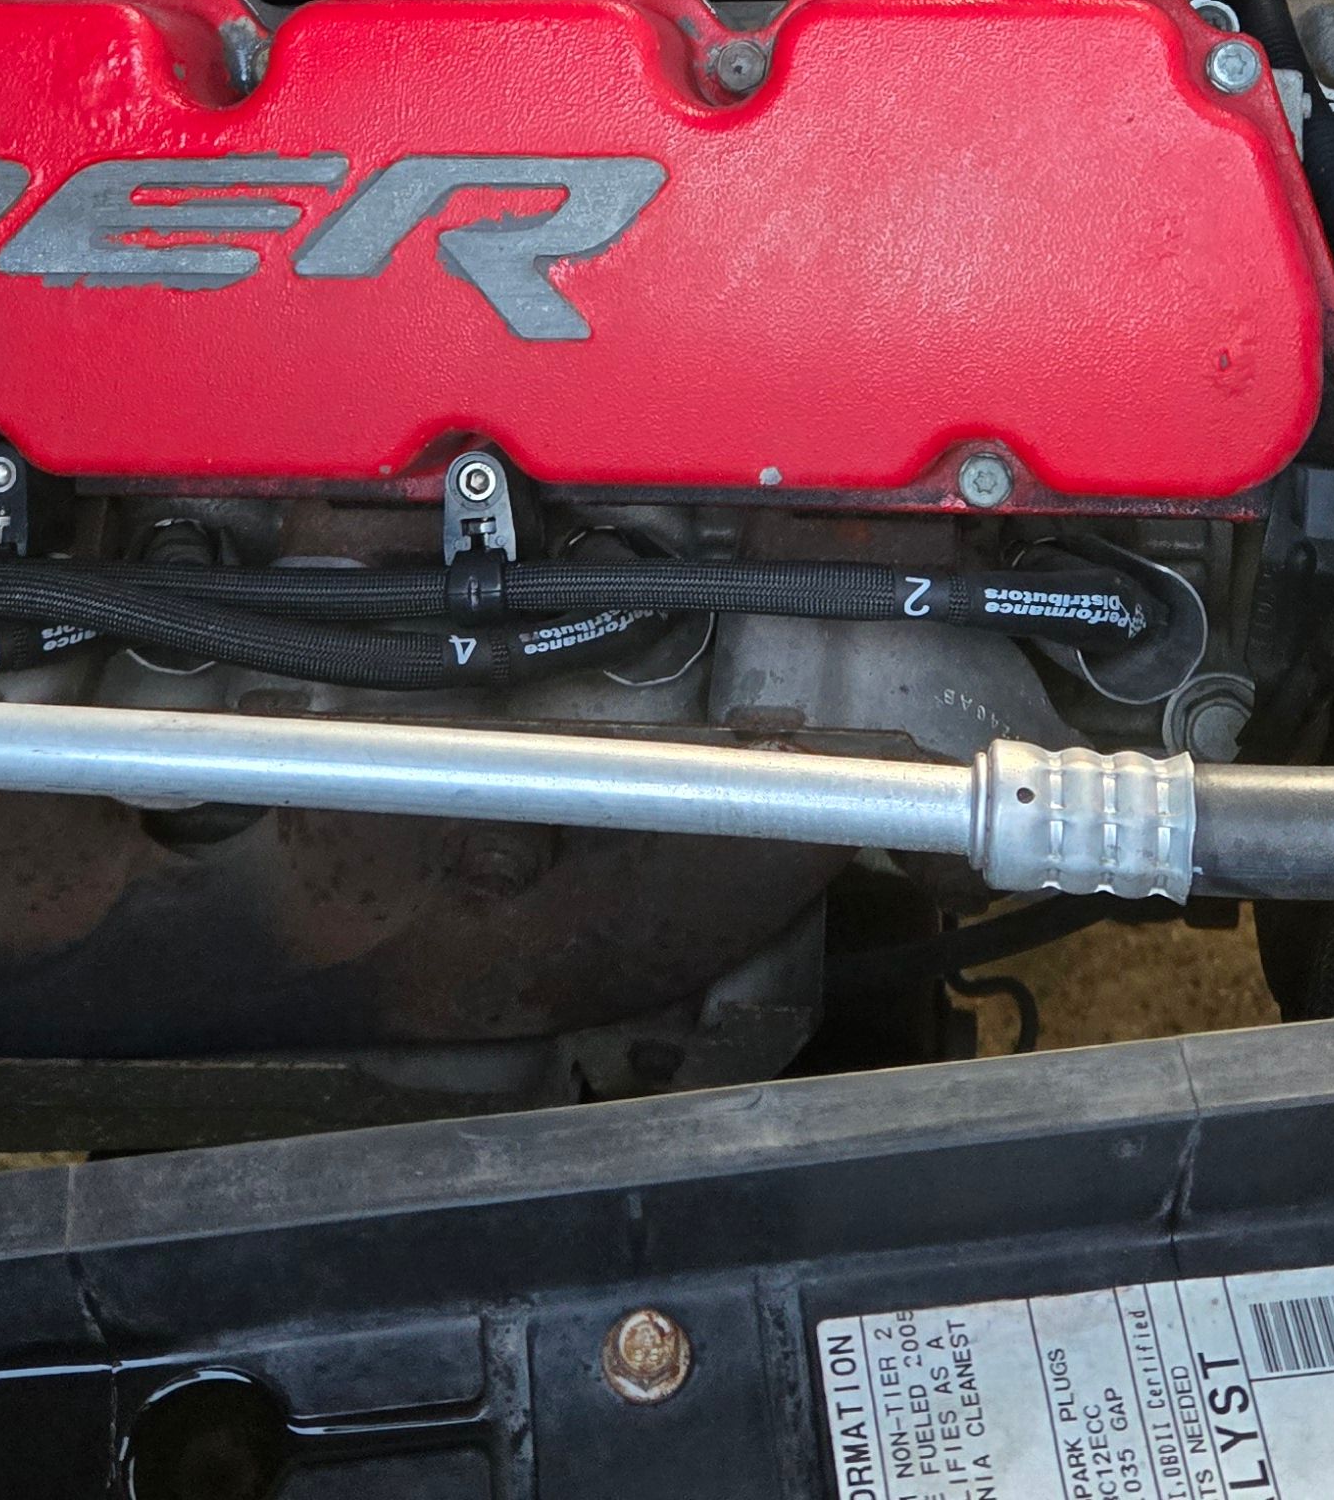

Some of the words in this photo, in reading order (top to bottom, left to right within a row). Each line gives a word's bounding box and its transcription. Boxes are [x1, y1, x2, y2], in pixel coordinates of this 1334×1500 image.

[903, 576, 932, 617] 2
[984, 587, 1120, 610] Distributors
[984, 601, 1130, 628] Performance
[43, 630, 97, 651] ance
[449, 635, 477, 665] 4
[519, 609, 623, 643] tributors
[874, 1326, 893, 1340] 2
[896, 1311, 923, 1368] 2005
[926, 1336, 946, 1350] A
[930, 1366, 953, 1394] AS
[946, 1319, 986, 1437] CLEANEST
[1047, 1348, 1078, 1422] PLUGS
[1128, 1310, 1166, 1409] Certified
[827, 1335, 876, 1500] ORMATION
[878, 1356, 915, 1479] NON-TIER
[908, 1384, 940, 1475] FUELED
[1104, 1387, 1129, 1432] GAP
[1171, 1365, 1208, 1454] NEEDED
[1197, 1352, 1275, 1500] LYST
[1064, 1437, 1093, 1500] PARK
[1152, 1422, 1187, 1500] I,OBDII
[1196, 1469, 1218, 1500] TS
